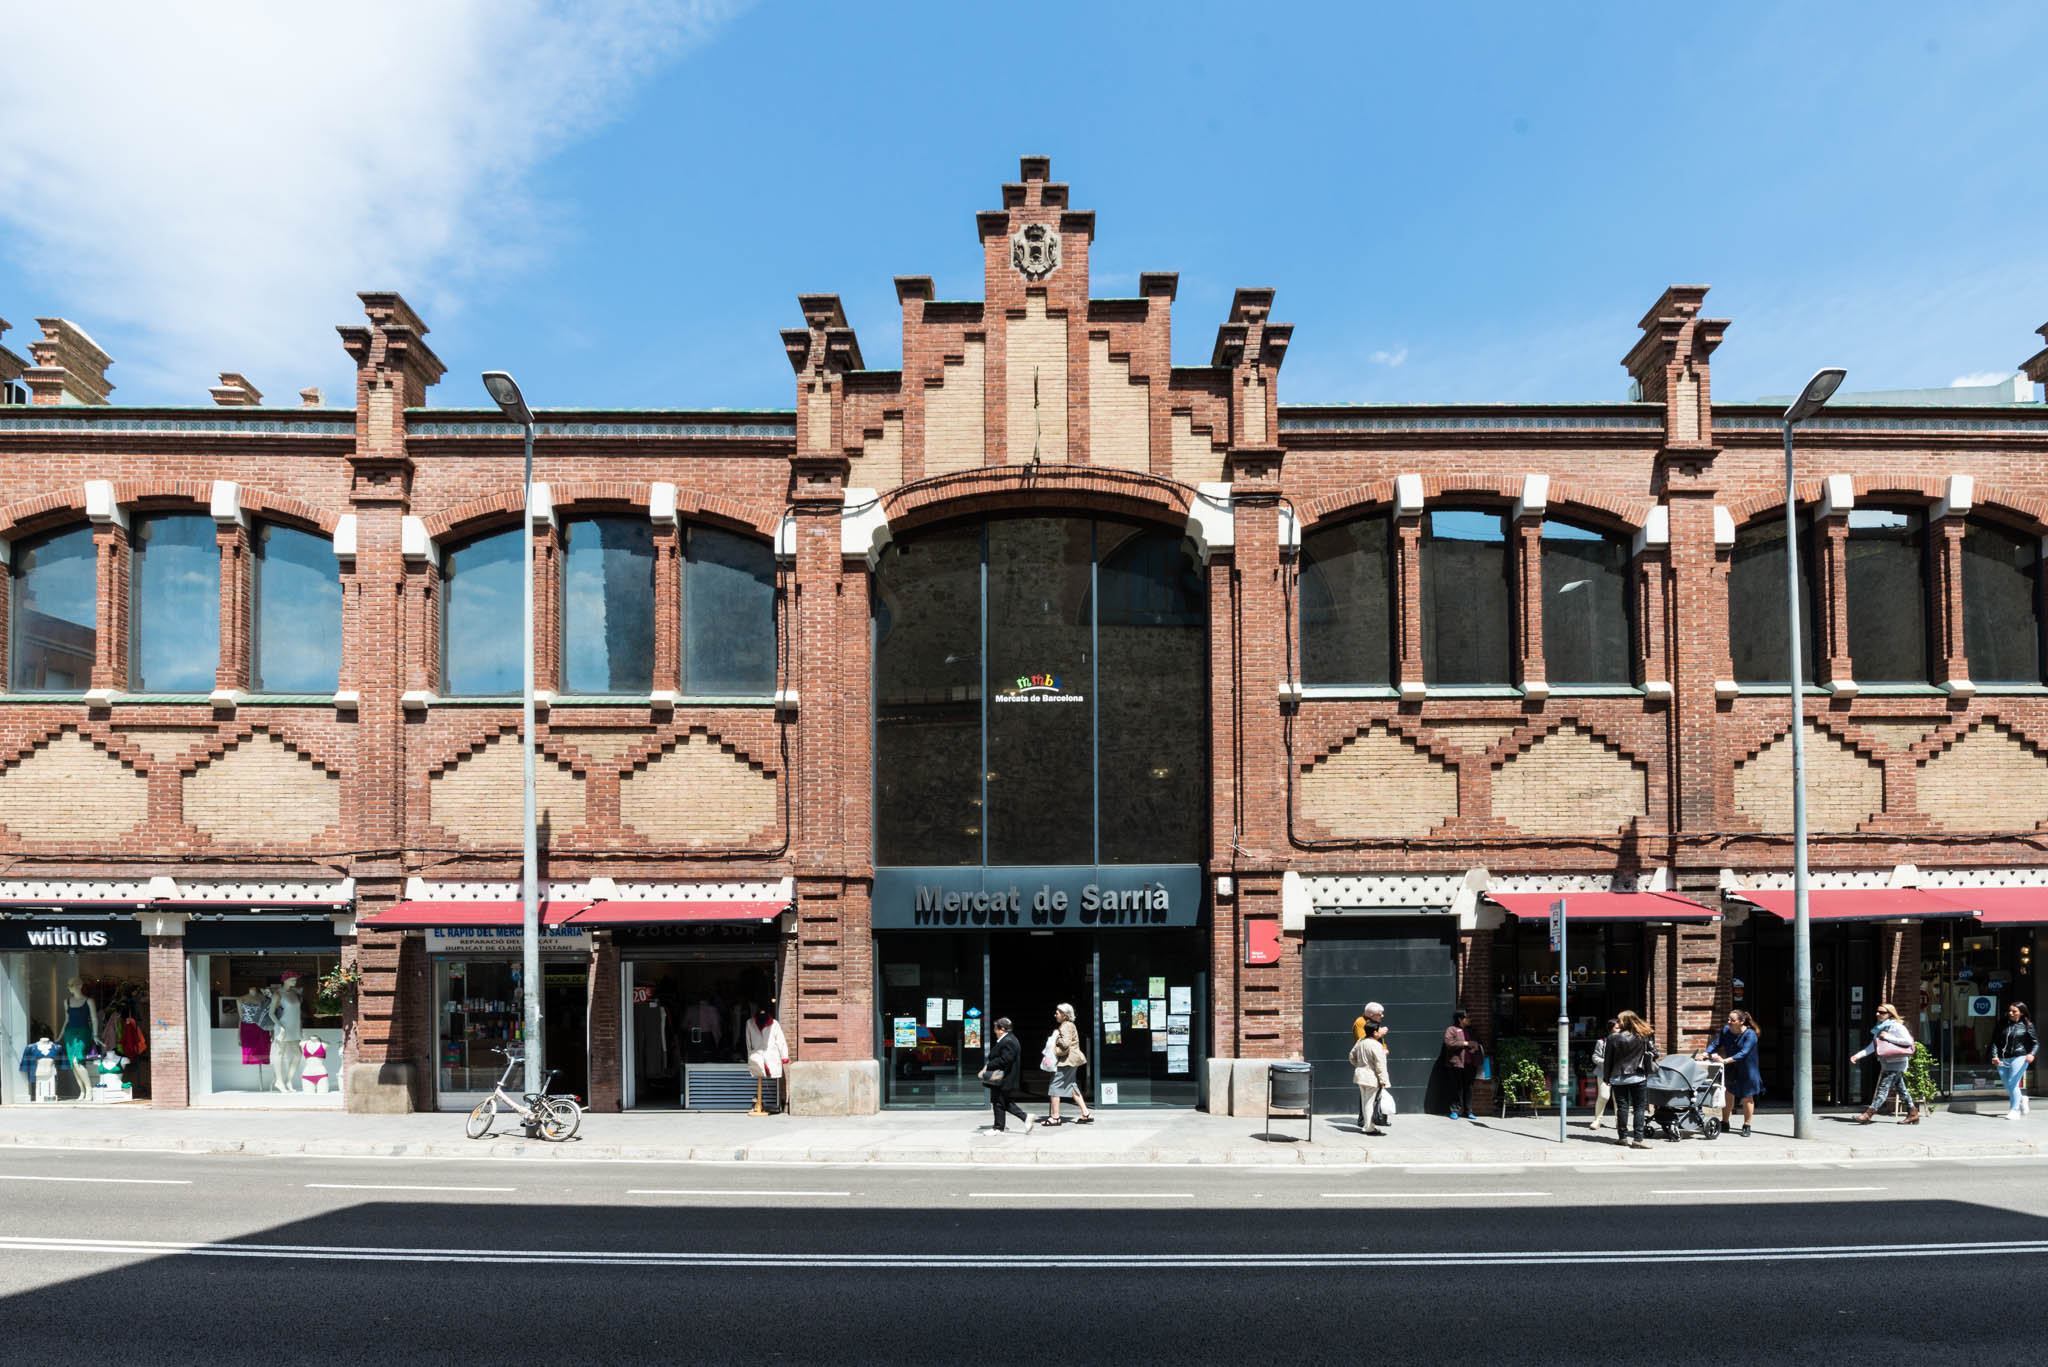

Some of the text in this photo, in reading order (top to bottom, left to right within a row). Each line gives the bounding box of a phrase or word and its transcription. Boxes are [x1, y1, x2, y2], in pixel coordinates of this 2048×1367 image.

[995, 694, 1083, 703] Mercats de Barcelona
[914, 881, 1169, 912] Mercat de Sarrià
[27, 926, 108, 946] with us
[434, 927, 445, 937] EL
[477, 927, 493, 937] DEL
[496, 927, 524, 937] MERC
